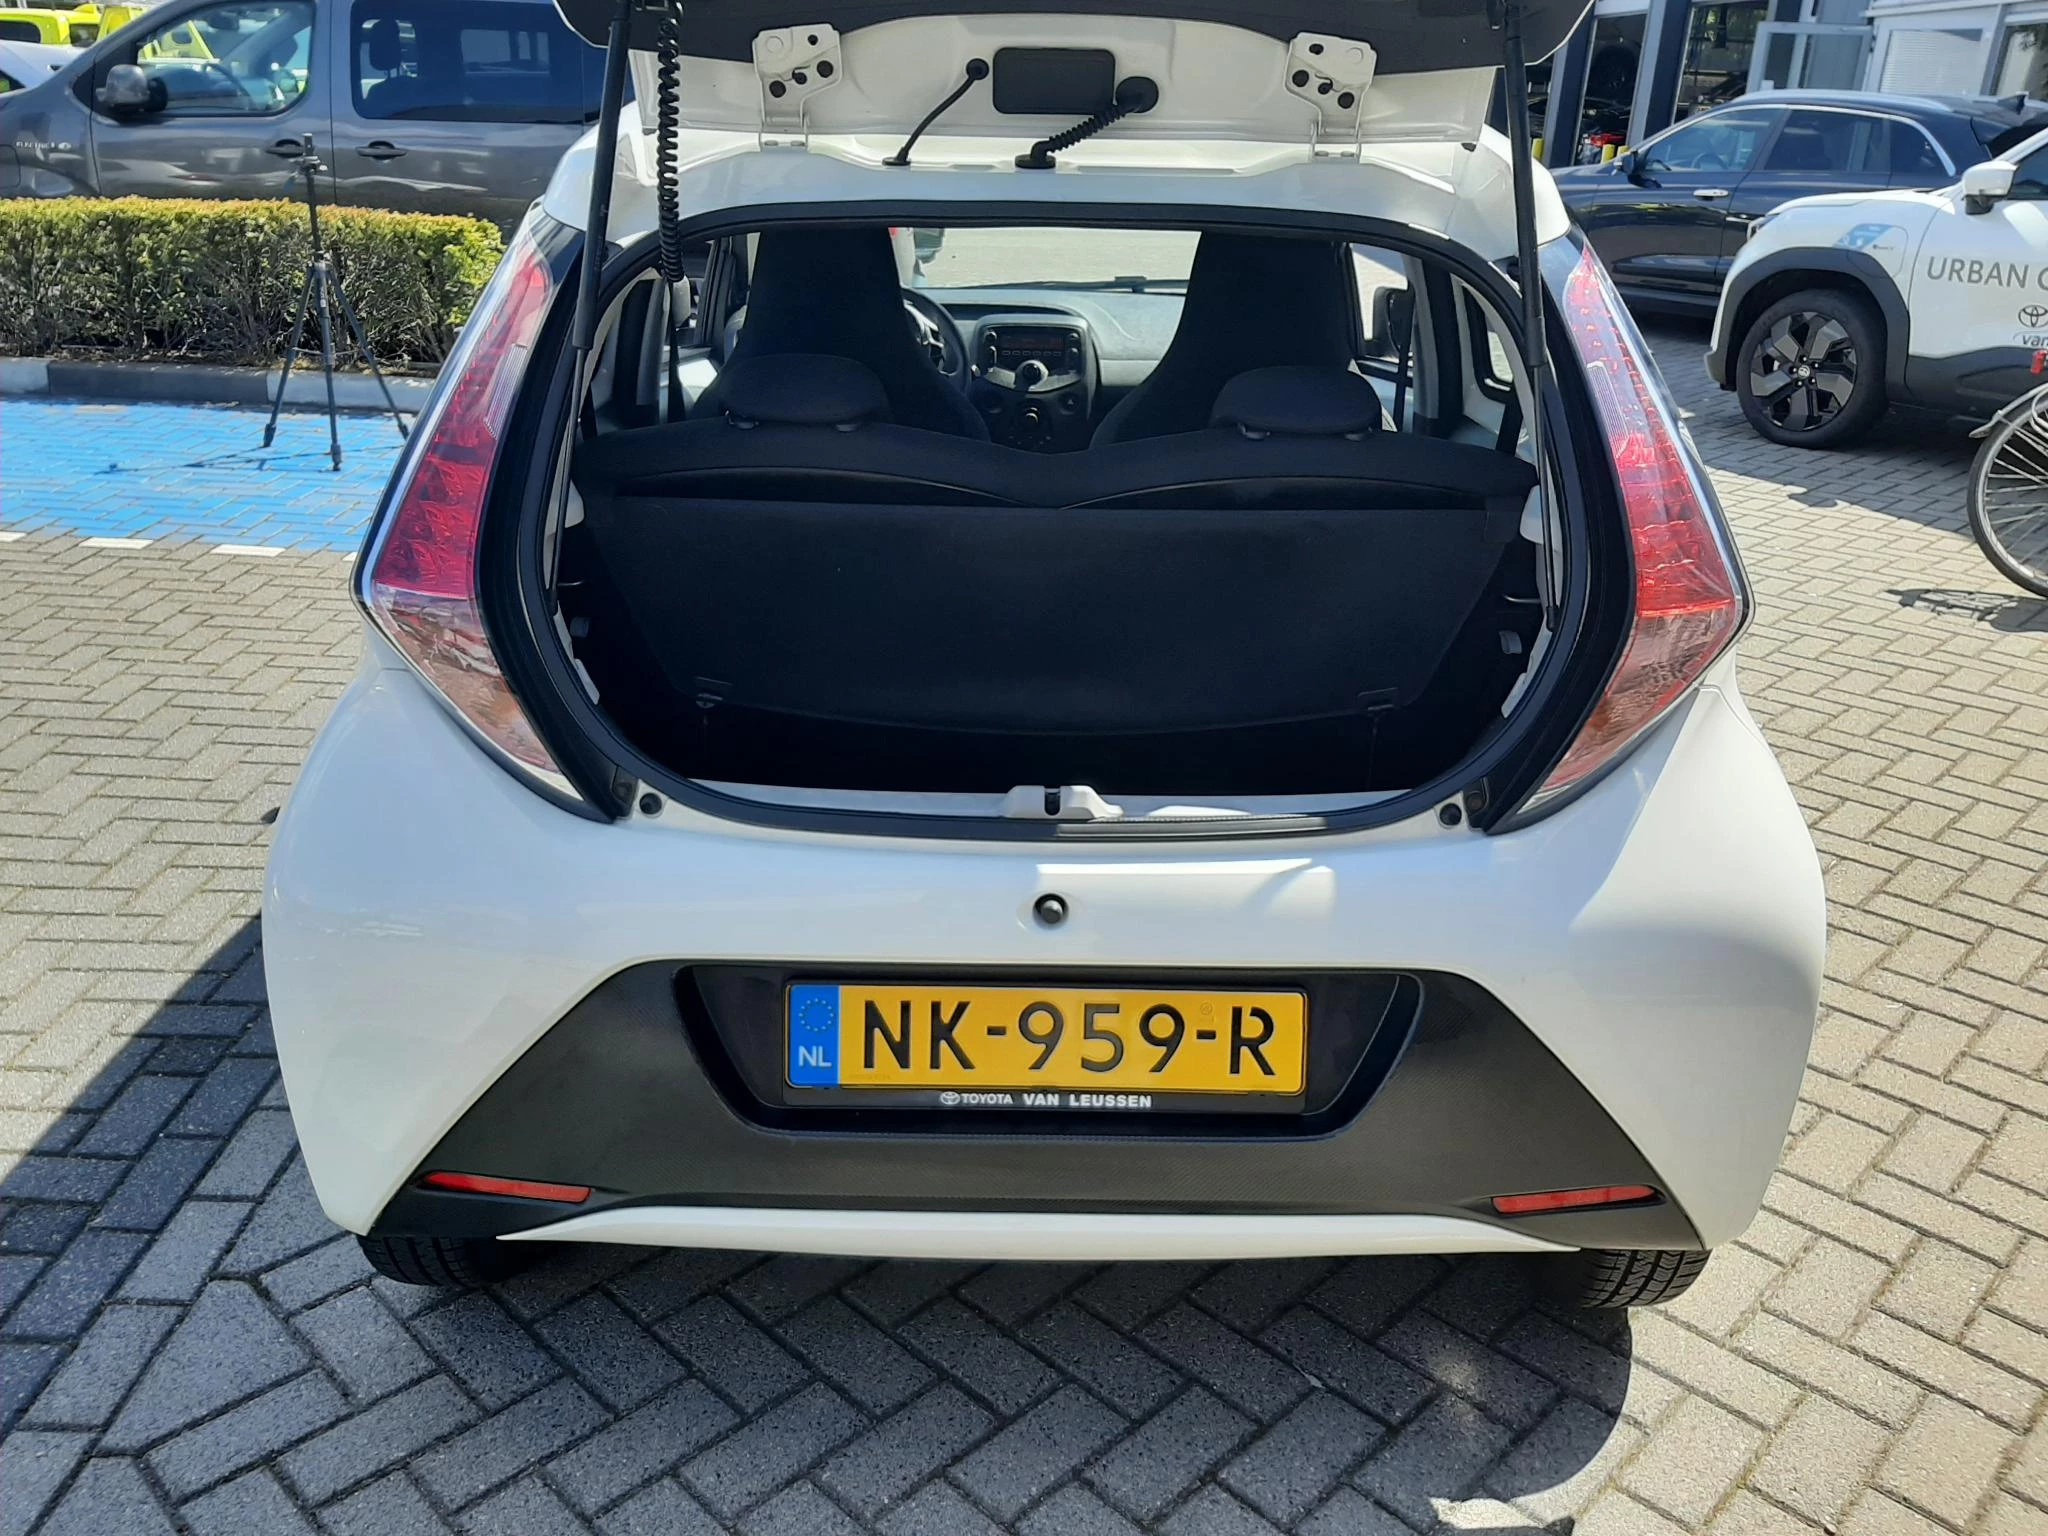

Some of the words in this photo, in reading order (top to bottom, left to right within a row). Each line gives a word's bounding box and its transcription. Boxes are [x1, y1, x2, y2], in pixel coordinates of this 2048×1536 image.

[1927, 256, 2030, 289] URBAN
[863, 1000, 1276, 1076] NK-959-R
[798, 1045, 832, 1067] NL
[962, 1092, 1013, 1105] TOYOTA
[1022, 1093, 1060, 1107] VAN
[1068, 1093, 1152, 1109] LEUSSEN
